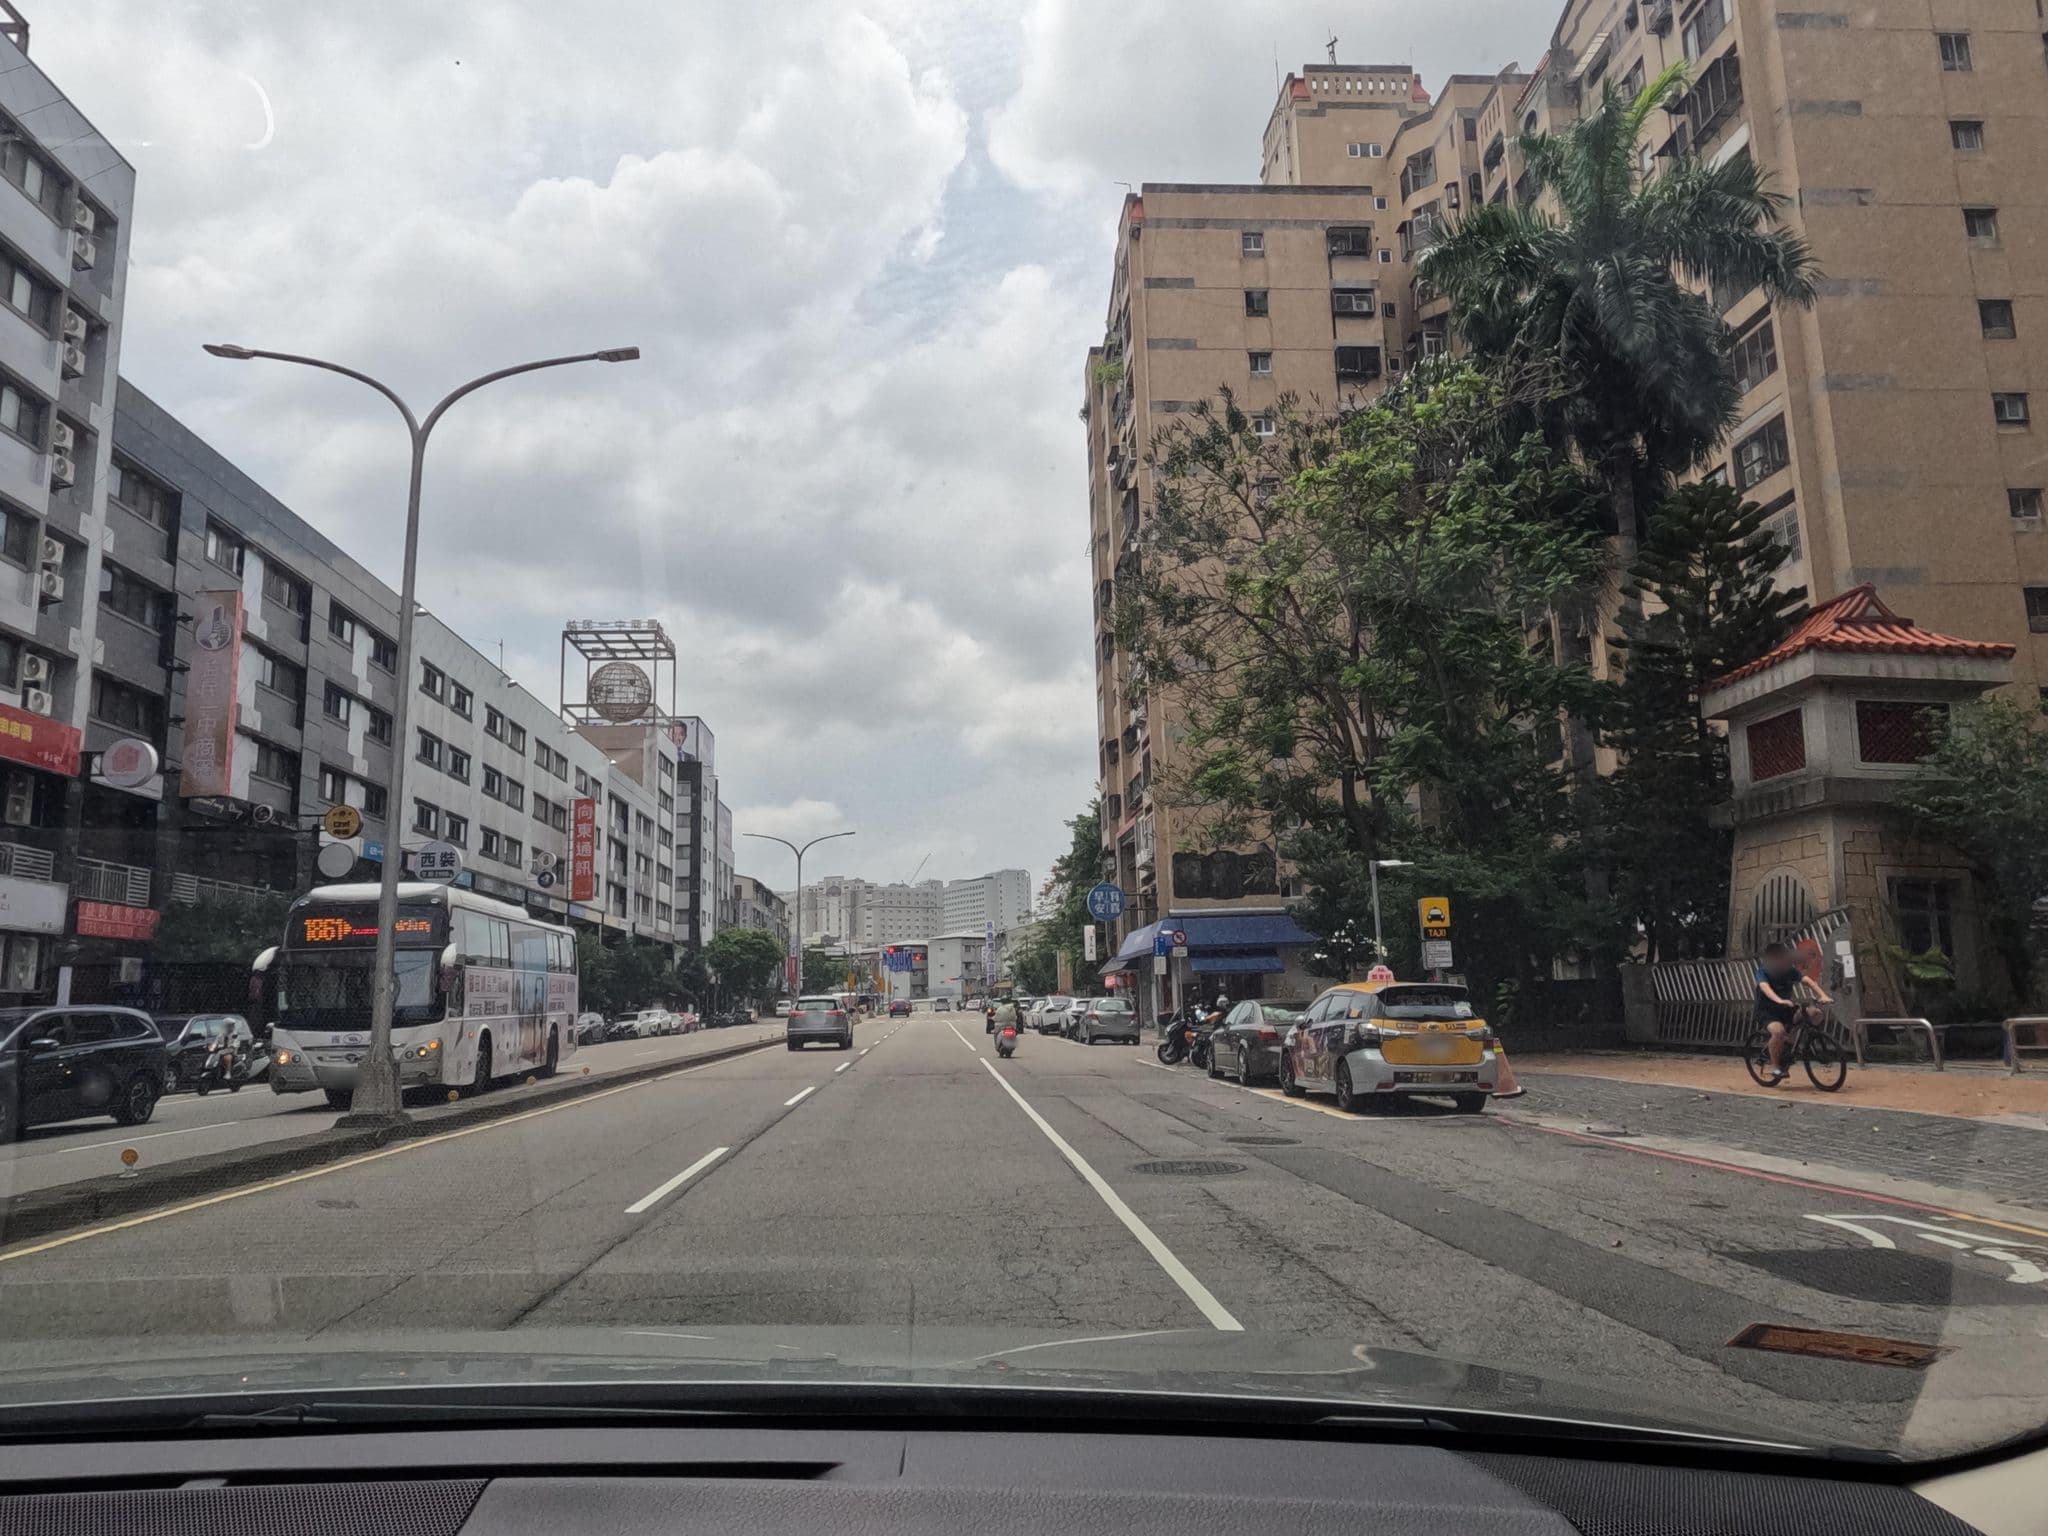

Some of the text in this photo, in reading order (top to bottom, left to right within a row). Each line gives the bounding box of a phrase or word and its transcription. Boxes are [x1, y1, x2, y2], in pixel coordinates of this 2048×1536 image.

[575, 804, 594, 876] 向東通訊
[420, 851, 456, 868] 西裝
[1427, 928, 1447, 938] TAXI
